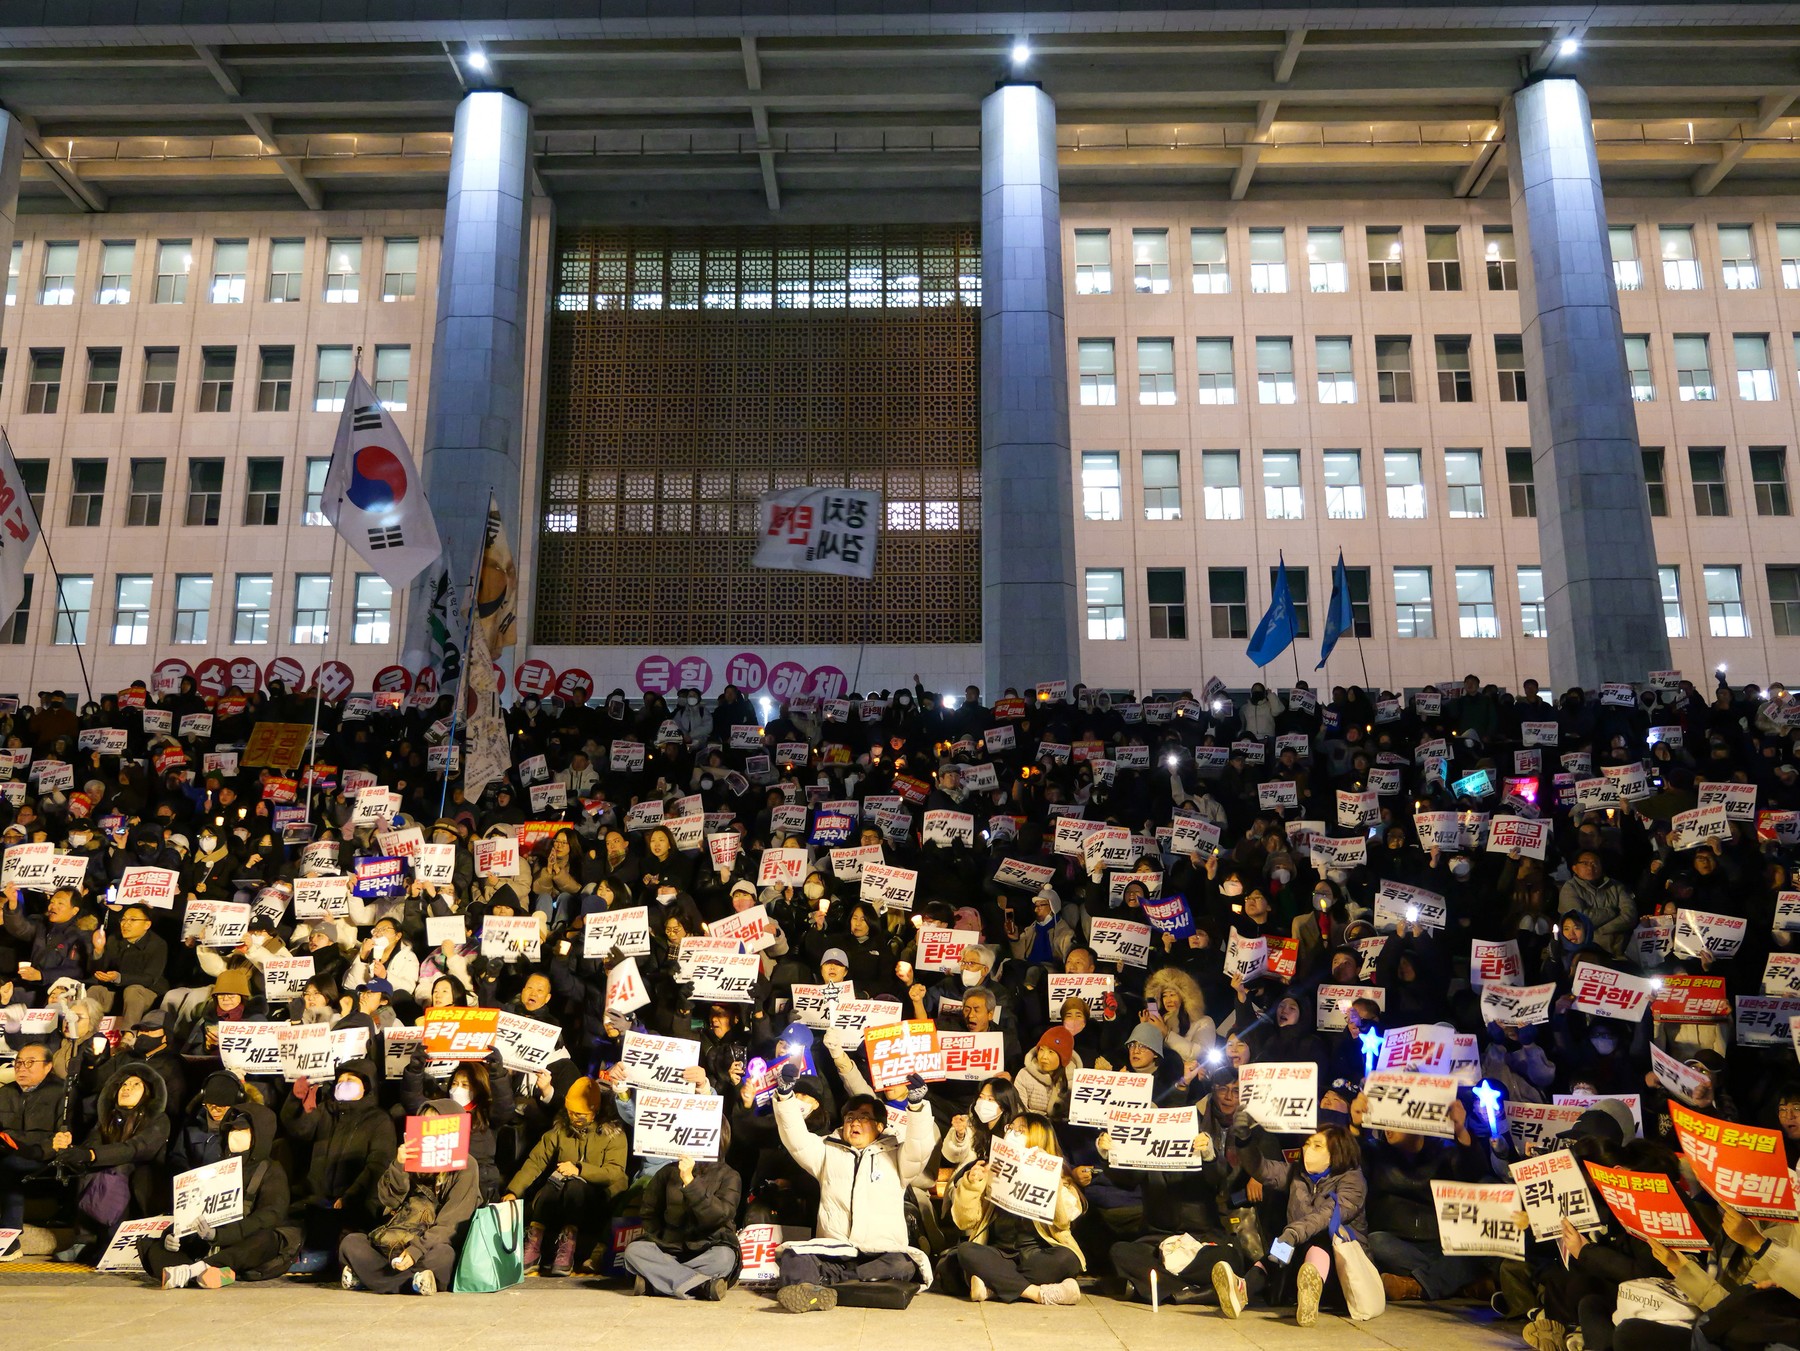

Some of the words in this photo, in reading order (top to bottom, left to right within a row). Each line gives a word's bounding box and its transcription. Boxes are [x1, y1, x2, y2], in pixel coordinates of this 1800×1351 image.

[193, 723, 211, 732] 체포!
[627, 758, 643, 767] 체포!
[1117, 753, 1132, 761] 즉각
[1132, 756, 1148, 765] 체포!
[1197, 752, 1212, 761] 즉각
[1563, 760, 1578, 769] 즉각
[1622, 764, 1642, 774] 윤석열
[40, 776, 55, 785] 즉각
[1620, 781, 1646, 795] 체포!
[1701, 784, 1726, 792] 내란수괴
[1260, 790, 1278, 800] 즉각
[361, 804, 388, 817] 체포!
[629, 810, 643, 819] 즉각
[643, 813, 663, 823] 체포!
[816, 816, 850, 829] 내란행위
[876, 818, 892, 828] 즉각
[925, 819, 946, 831] 즉각
[944, 826, 972, 837] 체포!
[1175, 818, 1201, 829] 내란수괴
[1494, 821, 1540, 837] 윤석열은
[1697, 821, 1726, 836] 체포!
[1057, 830, 1083, 842] 즉각
[1174, 828, 1200, 841] 즉각
[1493, 836, 1541, 849] 사퇴하라!
[1101, 848, 1131, 861] 체포!
[1312, 843, 1337, 855] 즉각
[1334, 850, 1365, 862] 체포!
[358, 860, 400, 878] 내란행위
[479, 852, 513, 872] 탄핵!
[834, 859, 857, 872] 즉각
[15, 864, 49, 878] 체포!
[1000, 866, 1025, 879] 즉각
[125, 872, 172, 887] 윤석열은
[296, 880, 322, 889] 내란수괴
[359, 874, 404, 891] 즉각수사!
[122, 887, 170, 898] 사퇴하라!
[863, 875, 889, 890] 즉각
[882, 886, 913, 903] 체포!
[1382, 887, 1413, 904] 즉각
[296, 890, 321, 903] 즉각
[317, 896, 348, 910] 체포!
[588, 914, 620, 925] 내란수괴
[621, 910, 645, 922] 윤석열
[1715, 917, 1743, 929] 윤석열
[1093, 920, 1126, 931] 내란수괴
[484, 930, 509, 944] 즉각
[588, 925, 617, 940] 즉각
[615, 930, 647, 947] 체포!
[922, 932, 952, 943] 윤석열
[682, 939, 711, 949] 내란수괴
[1092, 930, 1122, 944] 즉각
[1115, 941, 1148, 958] 체포!
[1704, 936, 1739, 952] 체포!
[265, 960, 291, 969] 내란수괴
[693, 954, 727, 966] 내란수괴
[728, 955, 757, 966] 윤석열
[267, 971, 289, 984] 즉각
[692, 966, 724, 981] 즉각
[1579, 968, 1617, 984] 윤석열
[1765, 966, 1796, 979] 즉각
[1050, 976, 1082, 986] 내란수괴
[1692, 978, 1722, 988] 윤석열
[1051, 989, 1081, 1002] 즉각
[1482, 994, 1520, 1010] 즉각
[1577, 983, 1643, 1010] 탄핵!
[795, 997, 823, 1010] 즉각
[835, 1002, 869, 1012] 내란수괴
[870, 1004, 899, 1015] 윤석열
[1684, 998, 1723, 1015] 탄핵!
[1738, 999, 1780, 1010] 내란수괴
[834, 1015, 867, 1030] 즉각
[1738, 1011, 1776, 1026] 즉각
[220, 1024, 253, 1035] 내란수괴
[424, 1022, 460, 1040] 즉각
[450, 1032, 494, 1050] 탄핵!
[221, 1037, 251, 1054] 즉각
[280, 1043, 298, 1060] 즉각
[297, 1051, 331, 1070] 체포!
[623, 1049, 660, 1069] 즉각
[946, 1048, 999, 1072] 탄핵!
[1386, 1040, 1445, 1068] 탄핵!
[1075, 1073, 1115, 1084] 내란수괴
[1116, 1075, 1148, 1088] 윤석열
[1074, 1086, 1111, 1105] 즉각
[1366, 1084, 1409, 1103] 즉각
[638, 1096, 682, 1110] 내란수괴
[683, 1097, 719, 1112] 윤석열
[1507, 1105, 1545, 1118] 내란수괴
[1108, 1110, 1154, 1124] 내란수괴
[1156, 1110, 1193, 1124] 윤석열
[638, 1110, 677, 1132] 즉각
[669, 1126, 719, 1148] 체포!
[1510, 1121, 1543, 1142] 즉각
[1672, 1108, 1720, 1142] 내란수괴
[1722, 1128, 1777, 1154] 윤석열
[1110, 1125, 1152, 1146] 즉각
[1146, 1139, 1195, 1158] 체포!
[1515, 1164, 1549, 1183] 내란수괴
[1679, 1131, 1718, 1173] 즉각
[1714, 1169, 1789, 1205] 탄핵!
[1591, 1166, 1629, 1189] 내란수괴
[1631, 1175, 1670, 1194] 윤석열
[1008, 1180, 1056, 1210] 체포!
[1524, 1180, 1555, 1207] 즉각
[1601, 1184, 1636, 1216] 즉각
[202, 1188, 241, 1215] 체포!
[120, 1221, 155, 1233] 내란수괴
[1440, 1202, 1479, 1224] 즉각
[1479, 1218, 1522, 1243] 체포!
[1639, 1208, 1692, 1236] 탄핵!
[1618, 1286, 1664, 1312] hilosophy
